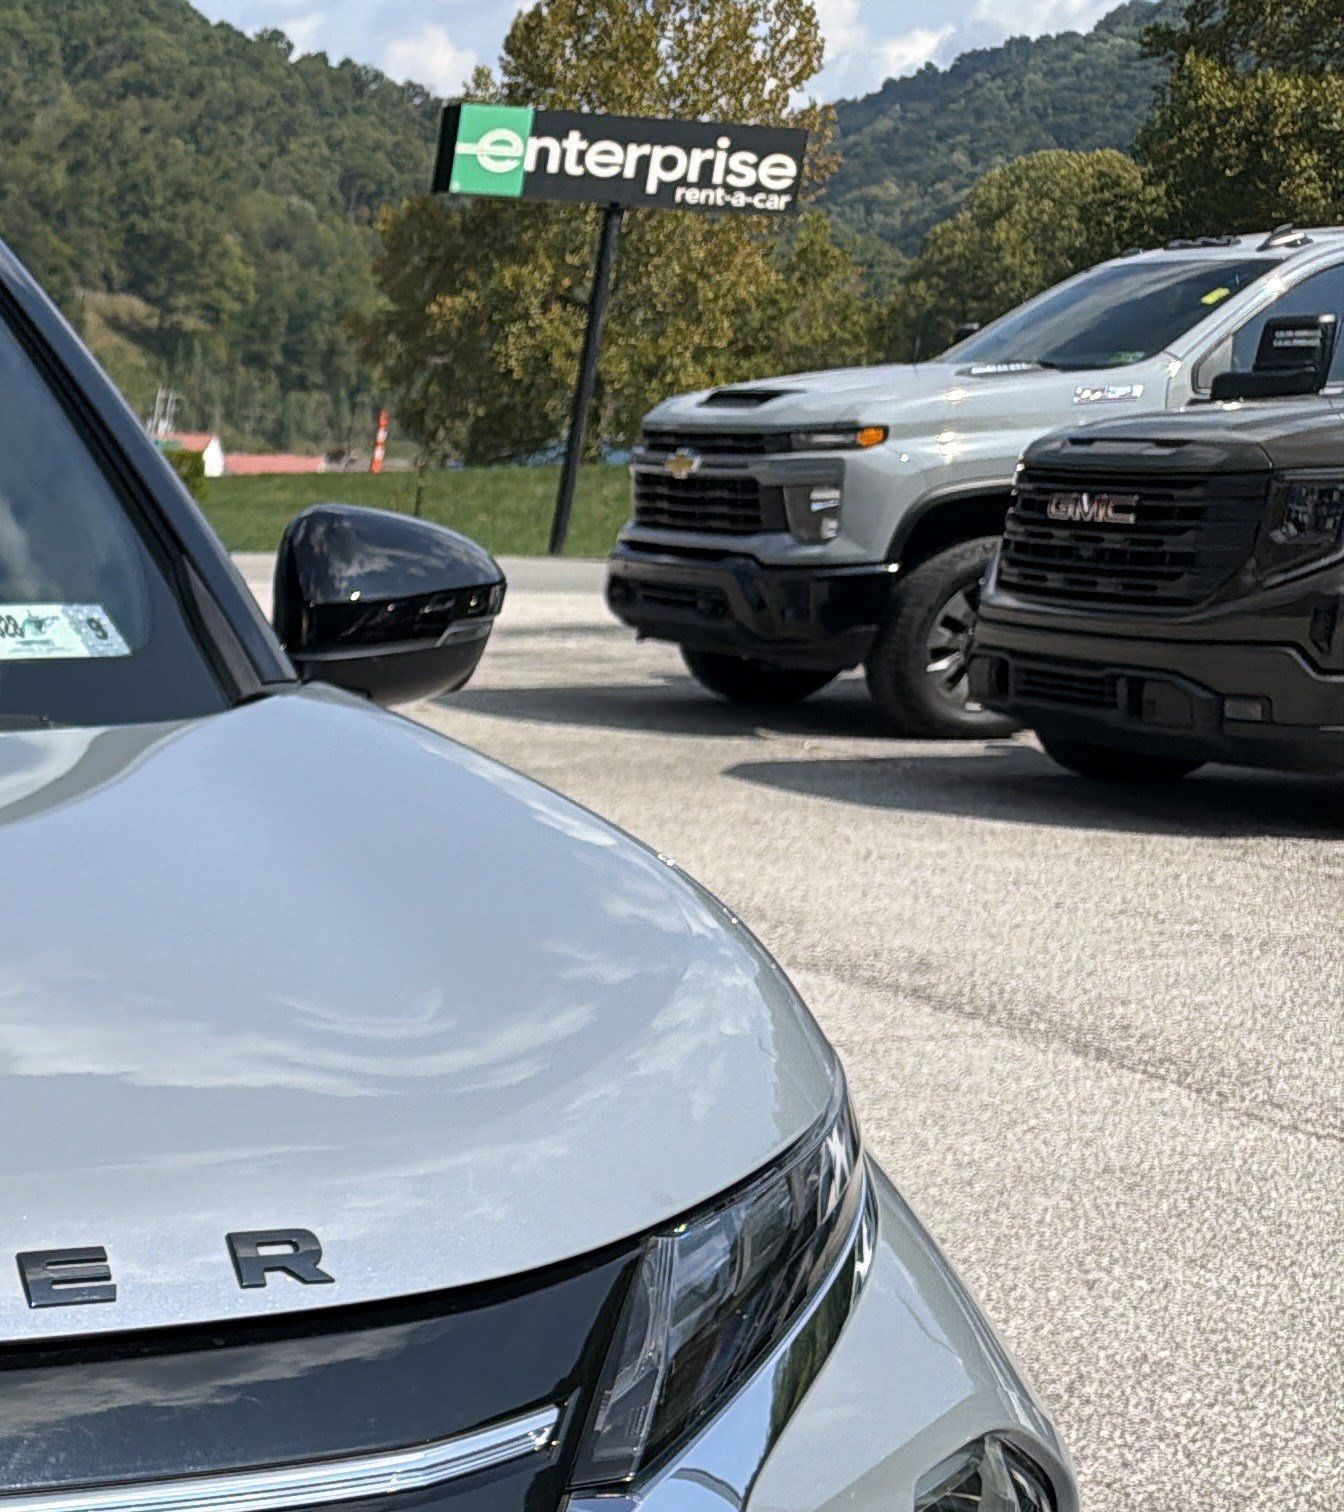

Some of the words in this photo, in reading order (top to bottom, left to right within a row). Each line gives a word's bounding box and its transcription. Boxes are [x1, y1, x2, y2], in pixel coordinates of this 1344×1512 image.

[458, 127, 798, 195] enterprise
[674, 185, 793, 211] rent-a-car
[1046, 491, 1140, 525] GMC
